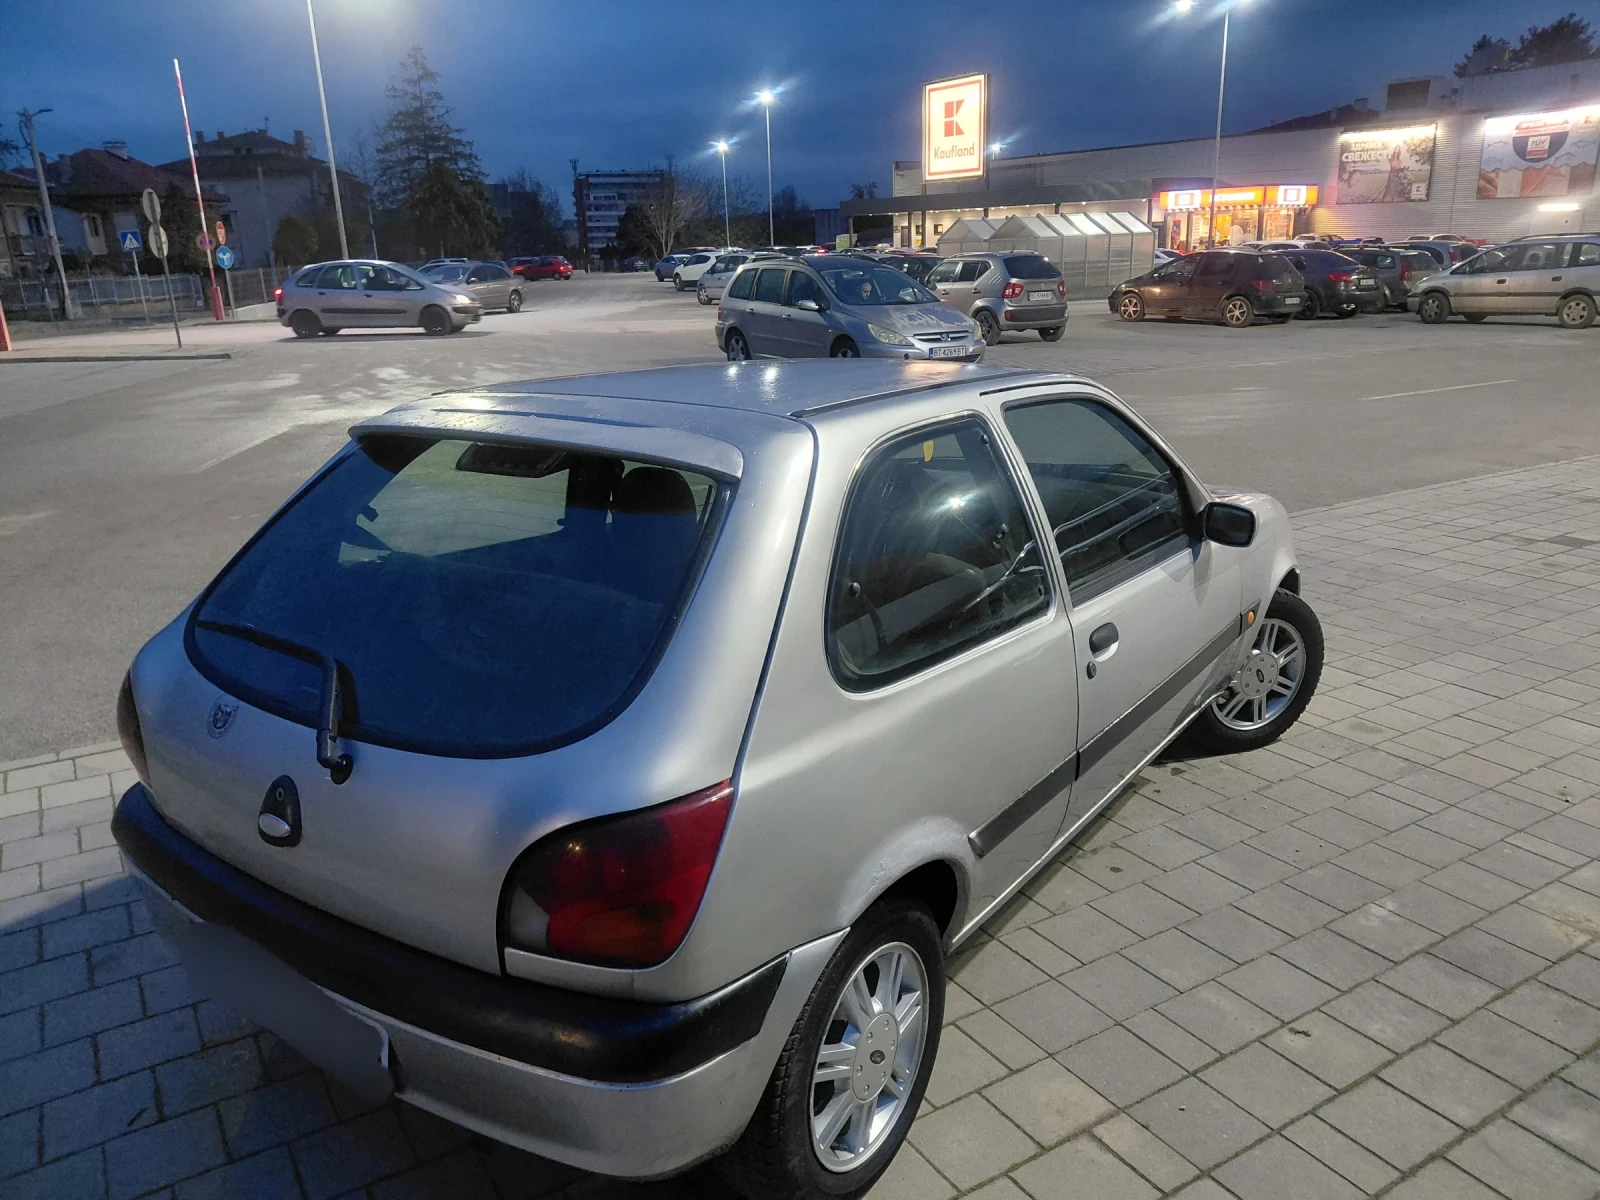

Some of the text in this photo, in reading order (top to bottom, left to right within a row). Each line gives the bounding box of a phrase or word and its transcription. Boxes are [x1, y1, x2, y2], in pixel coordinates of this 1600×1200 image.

[944, 99, 965, 137] K
[933, 143, 975, 159] Kaufland
[933, 348, 941, 356] BT
